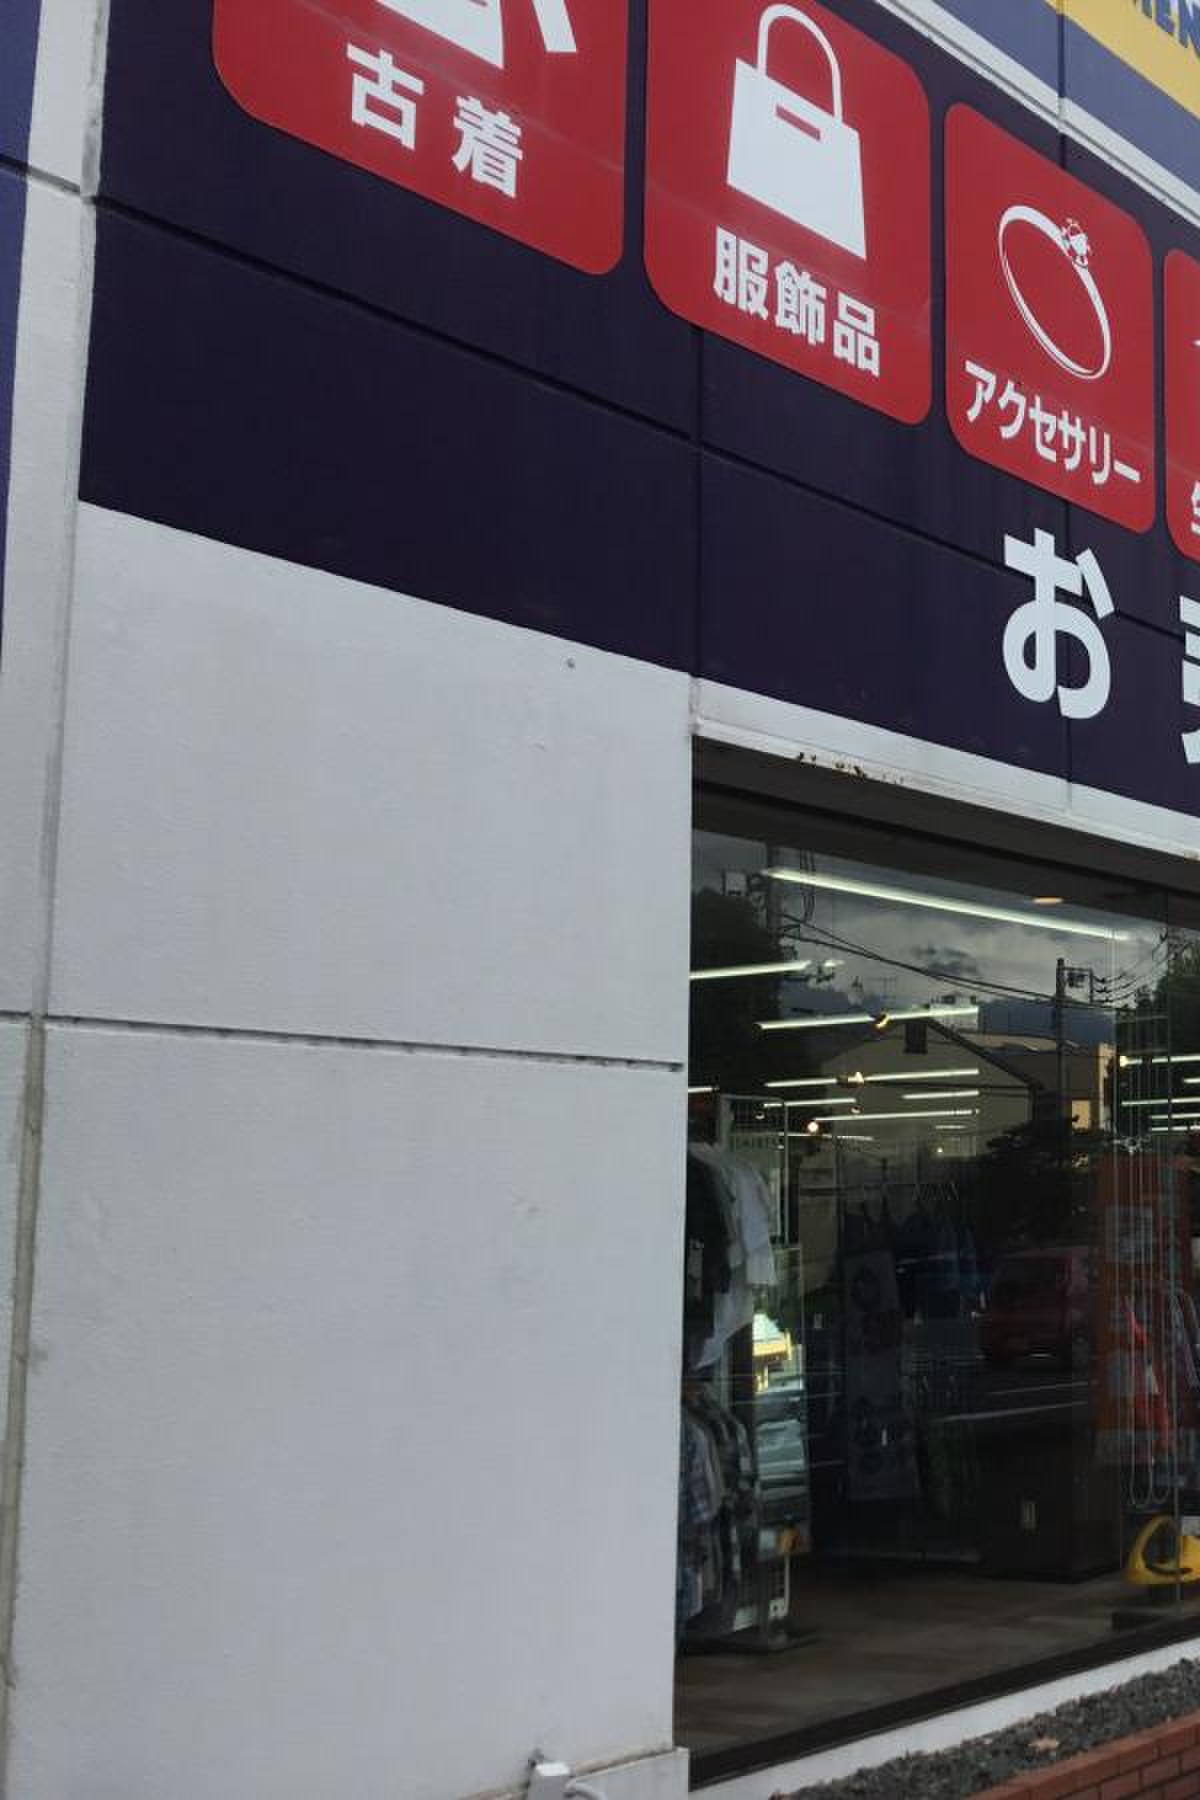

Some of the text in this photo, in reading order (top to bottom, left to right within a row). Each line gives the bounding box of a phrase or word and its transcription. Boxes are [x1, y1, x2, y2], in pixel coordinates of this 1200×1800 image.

[347, 43, 523, 198] 古着
[713, 226, 880, 378] 服飾品
[965, 360, 1140, 484] アクセサリー
